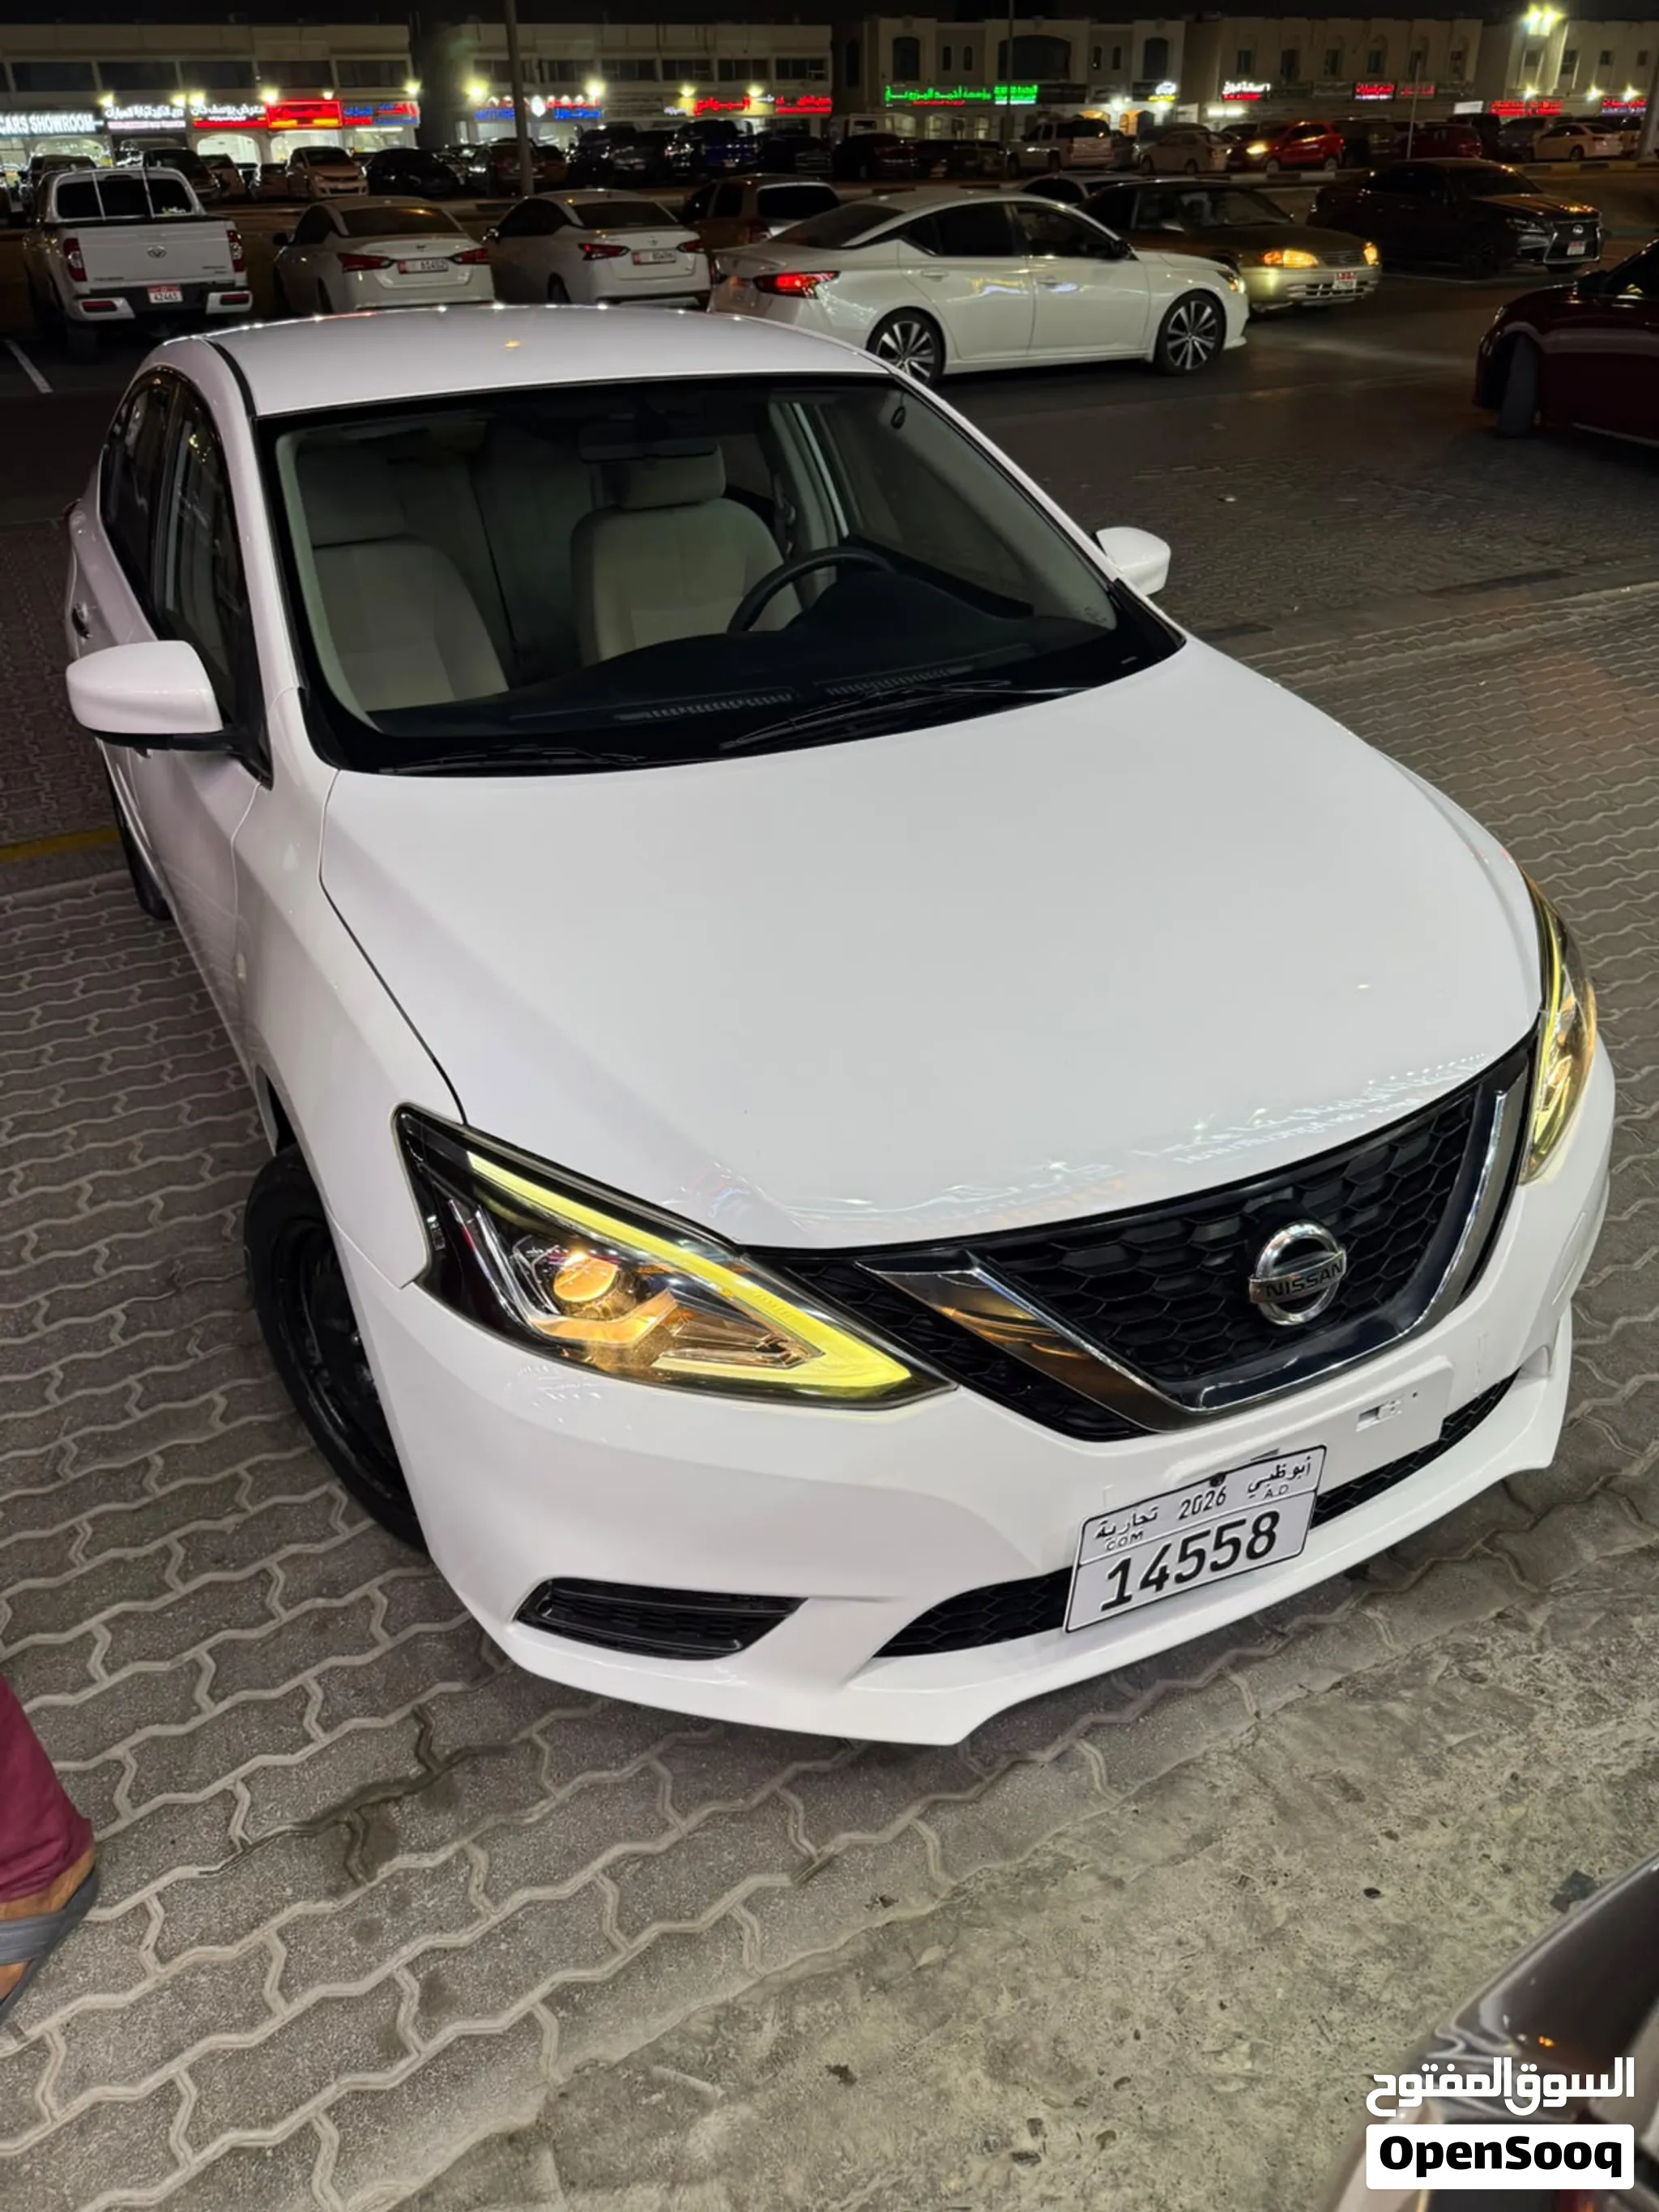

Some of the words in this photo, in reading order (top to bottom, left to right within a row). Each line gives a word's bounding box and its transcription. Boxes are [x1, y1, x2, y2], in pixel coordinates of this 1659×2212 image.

[30, 113, 96, 133] SHOWROOM
[1265, 1259, 1344, 1298] NISSAN
[1178, 1485, 1226, 1520] 2026
[1095, 1506, 1159, 1541] تجارية
[1105, 1530, 1144, 1551] COM
[1100, 1510, 1281, 1612] 14558
